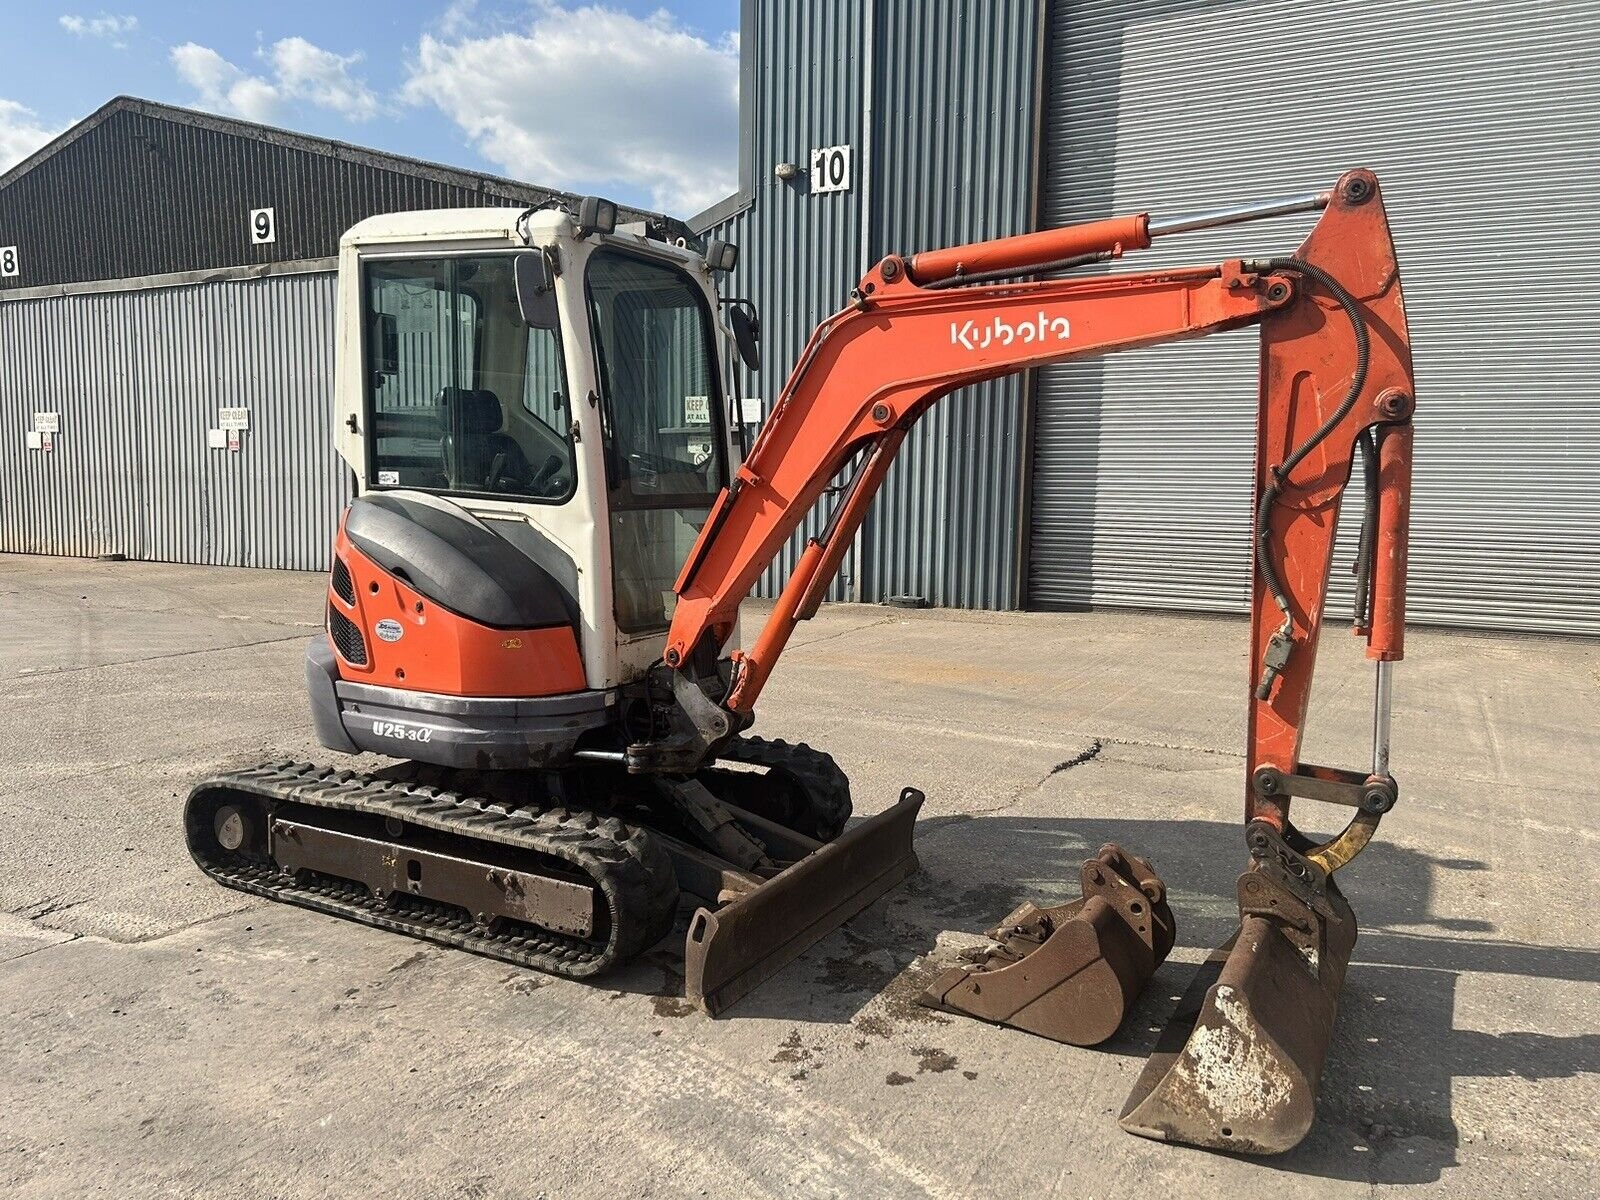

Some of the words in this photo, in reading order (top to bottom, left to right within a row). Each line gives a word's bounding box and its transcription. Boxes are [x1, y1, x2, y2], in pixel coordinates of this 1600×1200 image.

[815, 150, 845, 187] 10
[254, 211, 271, 240] 9
[3, 249, 16, 274] 8
[950, 310, 1070, 351] Kubota
[686, 400, 703, 411] KEEP
